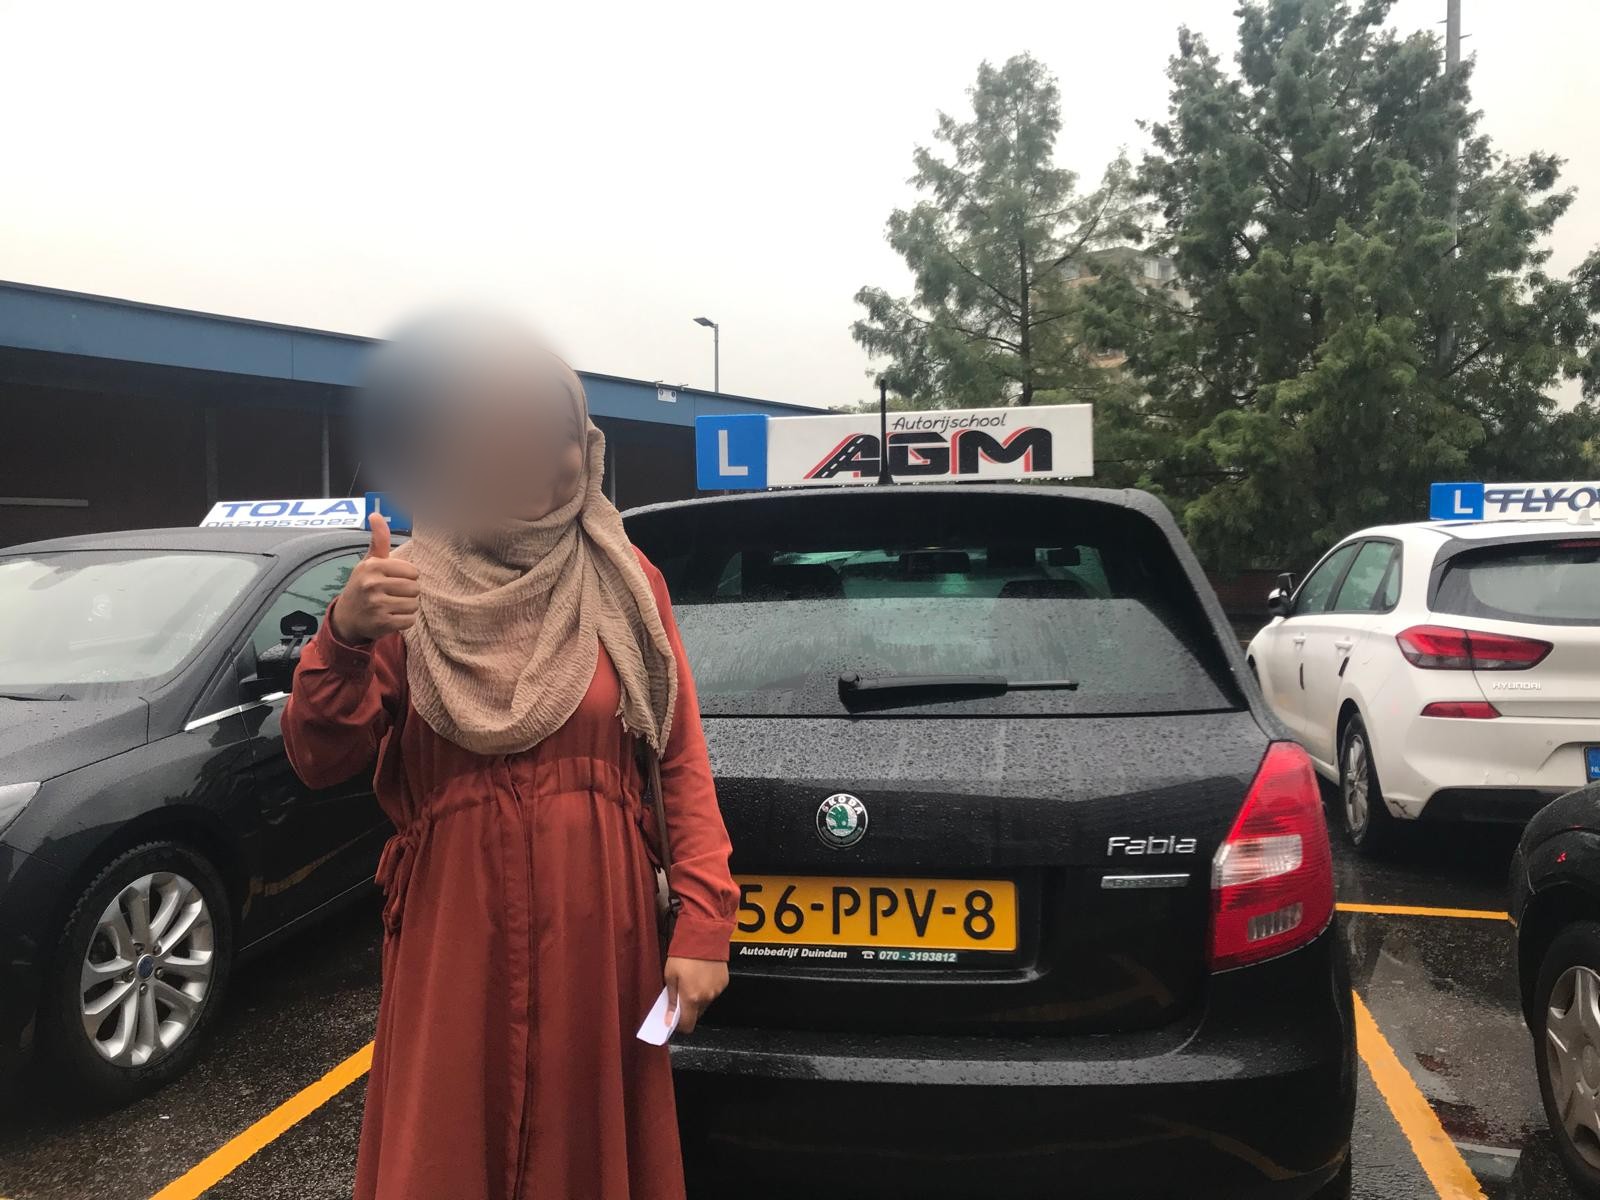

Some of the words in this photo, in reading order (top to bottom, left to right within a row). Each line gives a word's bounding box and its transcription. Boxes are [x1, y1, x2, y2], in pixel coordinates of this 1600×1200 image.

[891, 412, 1007, 433] Autorijschool
[717, 429, 749, 477] L
[803, 426, 1053, 479] AGM
[221, 500, 360, 518] TOLA
[1453, 489, 1474, 514] L
[1484, 486, 1600, 513] FLYO
[1492, 681, 1542, 690] HYUNDAI
[1106, 835, 1197, 856] Fabia
[737, 883, 996, 941] 56-PPV-8
[739, 946, 799, 959] Autobedrijf
[801, 948, 848, 959] Duindam
[878, 950, 900, 960] 070
[908, 952, 957, 962] 3193812
